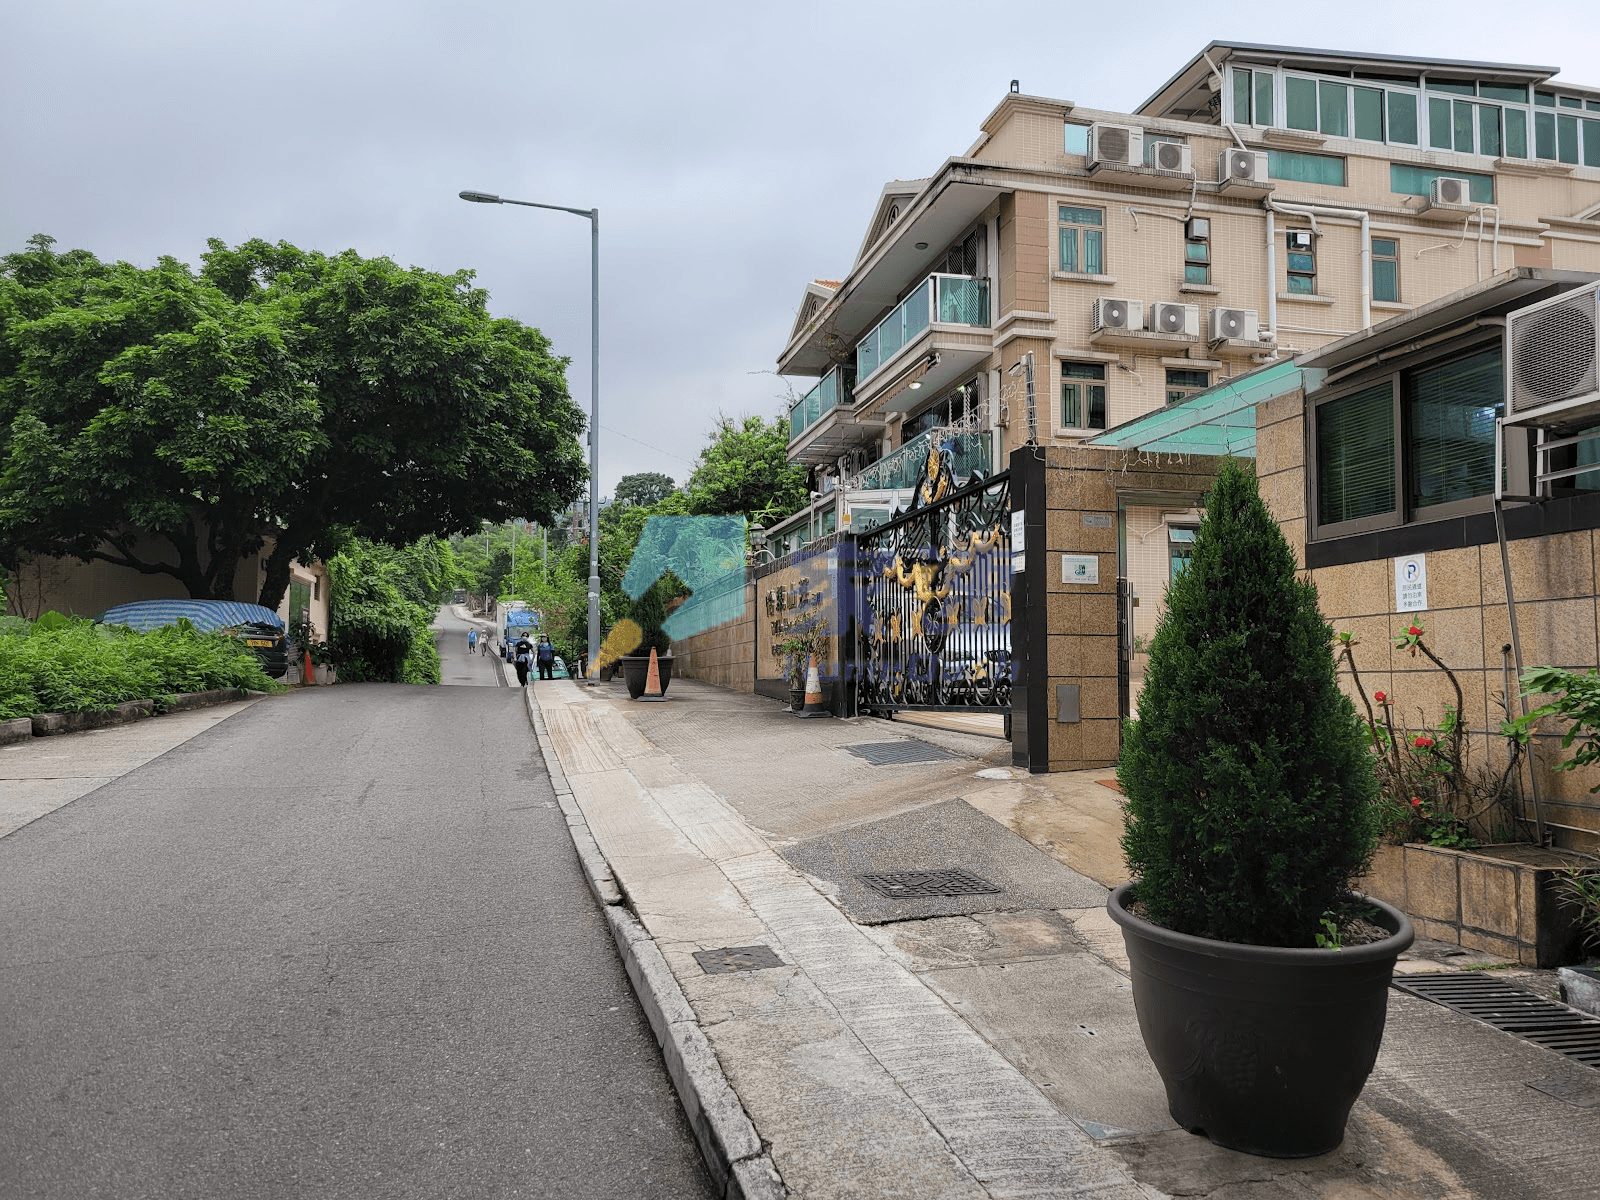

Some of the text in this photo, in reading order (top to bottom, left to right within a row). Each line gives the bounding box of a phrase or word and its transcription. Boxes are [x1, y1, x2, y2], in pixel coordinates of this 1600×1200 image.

[1402, 591, 1422, 599] 請勿泊車
[1403, 600, 1422, 608] 多謝合作
